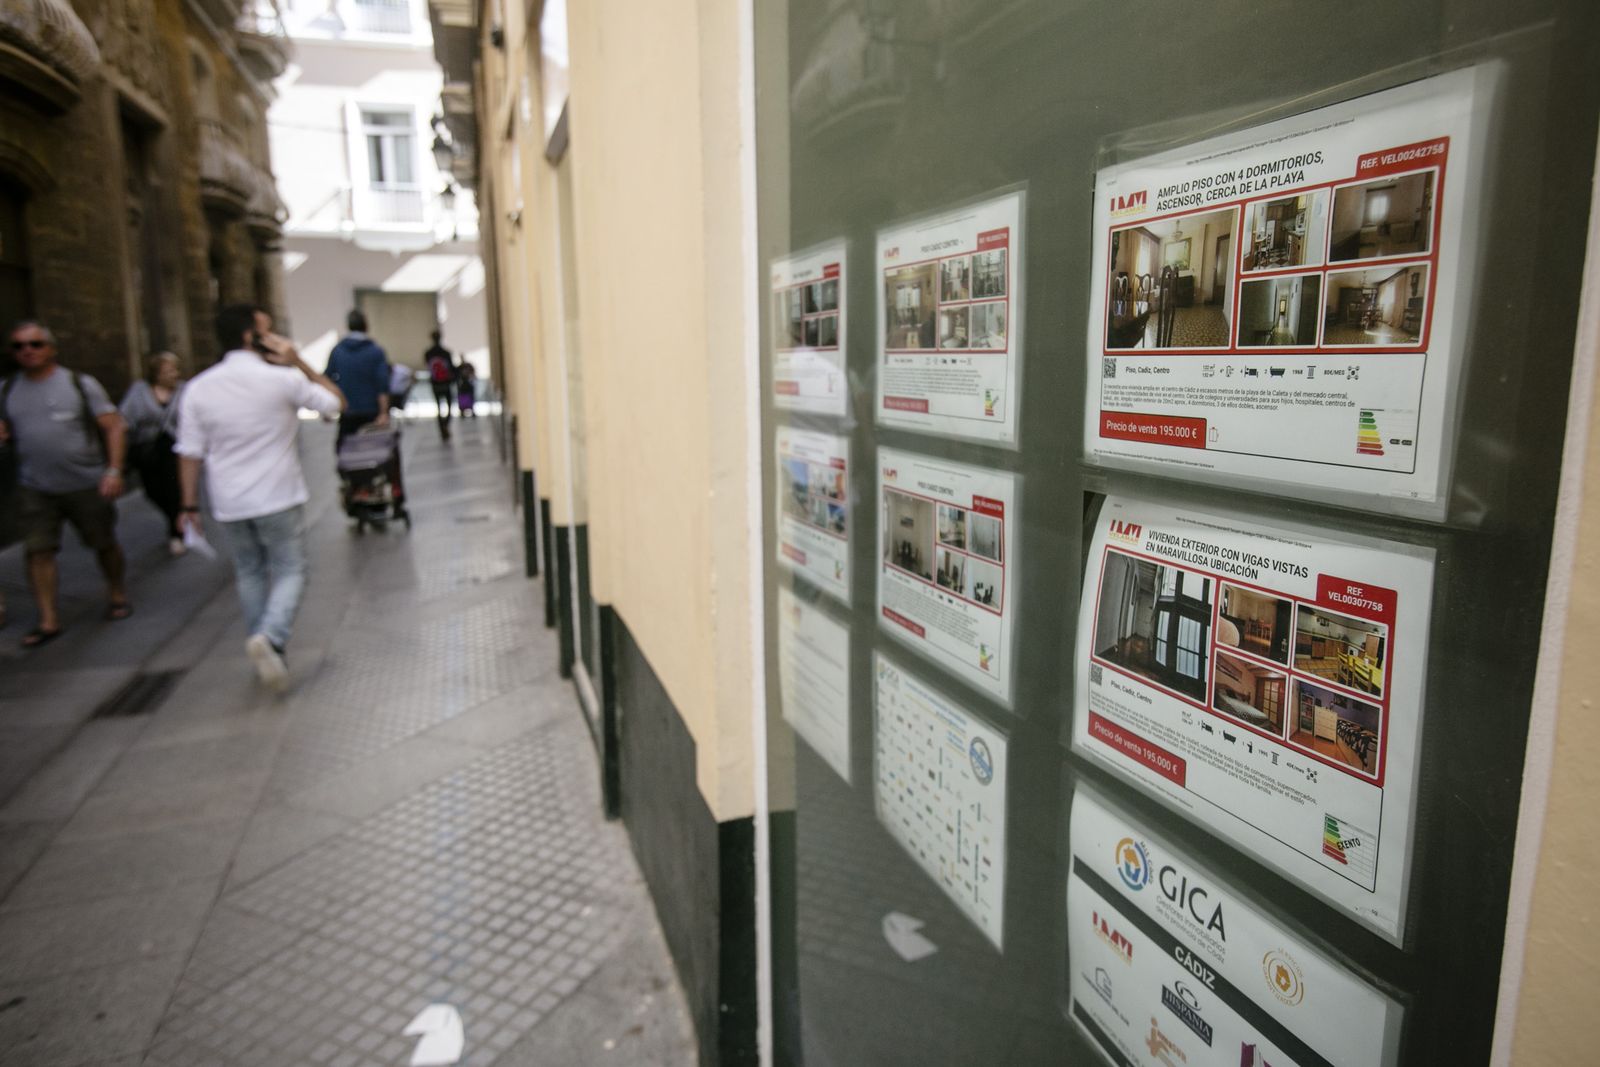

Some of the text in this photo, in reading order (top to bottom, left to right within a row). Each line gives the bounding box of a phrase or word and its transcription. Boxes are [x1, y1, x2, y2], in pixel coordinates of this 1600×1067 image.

[1157, 151, 1324, 200] AMPLIO PISO CON 4 DORMITORIOS,
[1360, 143, 1445, 170] REF. VEL00242758
[1156, 170, 1305, 212] ASCENSOR, CERCA DE LA PLAYA
[1126, 366, 1138, 375] Piso,
[1153, 366, 1170, 374] Centro
[1106, 420, 1197, 438] Precio de venta 195.000 €
[1146, 542, 1259, 580] EN MARAVILLOSA UBICACIÓN
[1149, 530, 1180, 546] VIVIENDA
[1181, 538, 1220, 556] EXTERIOR
[1220, 547, 1240, 562] CON
[1242, 552, 1270, 569] VIGAS
[1272, 558, 1310, 579] VISTAS
[1328, 590, 1384, 612] VEL00307758
[1346, 586, 1364, 598] REF.
[1094, 721, 1178, 775] Precio de venta 195.000 €
[1336, 838, 1361, 850] EXENTO
[1156, 896, 1184, 921] Gestores
[1159, 865, 1226, 942] GICA
[1156, 906, 1164, 915] de
[1164, 912, 1170, 920] la
[1170, 918, 1197, 942] provincia
[1198, 938, 1206, 948] de
[1174, 946, 1216, 990] CÁDIZ
[1165, 989, 1211, 1038] HISPANIA
